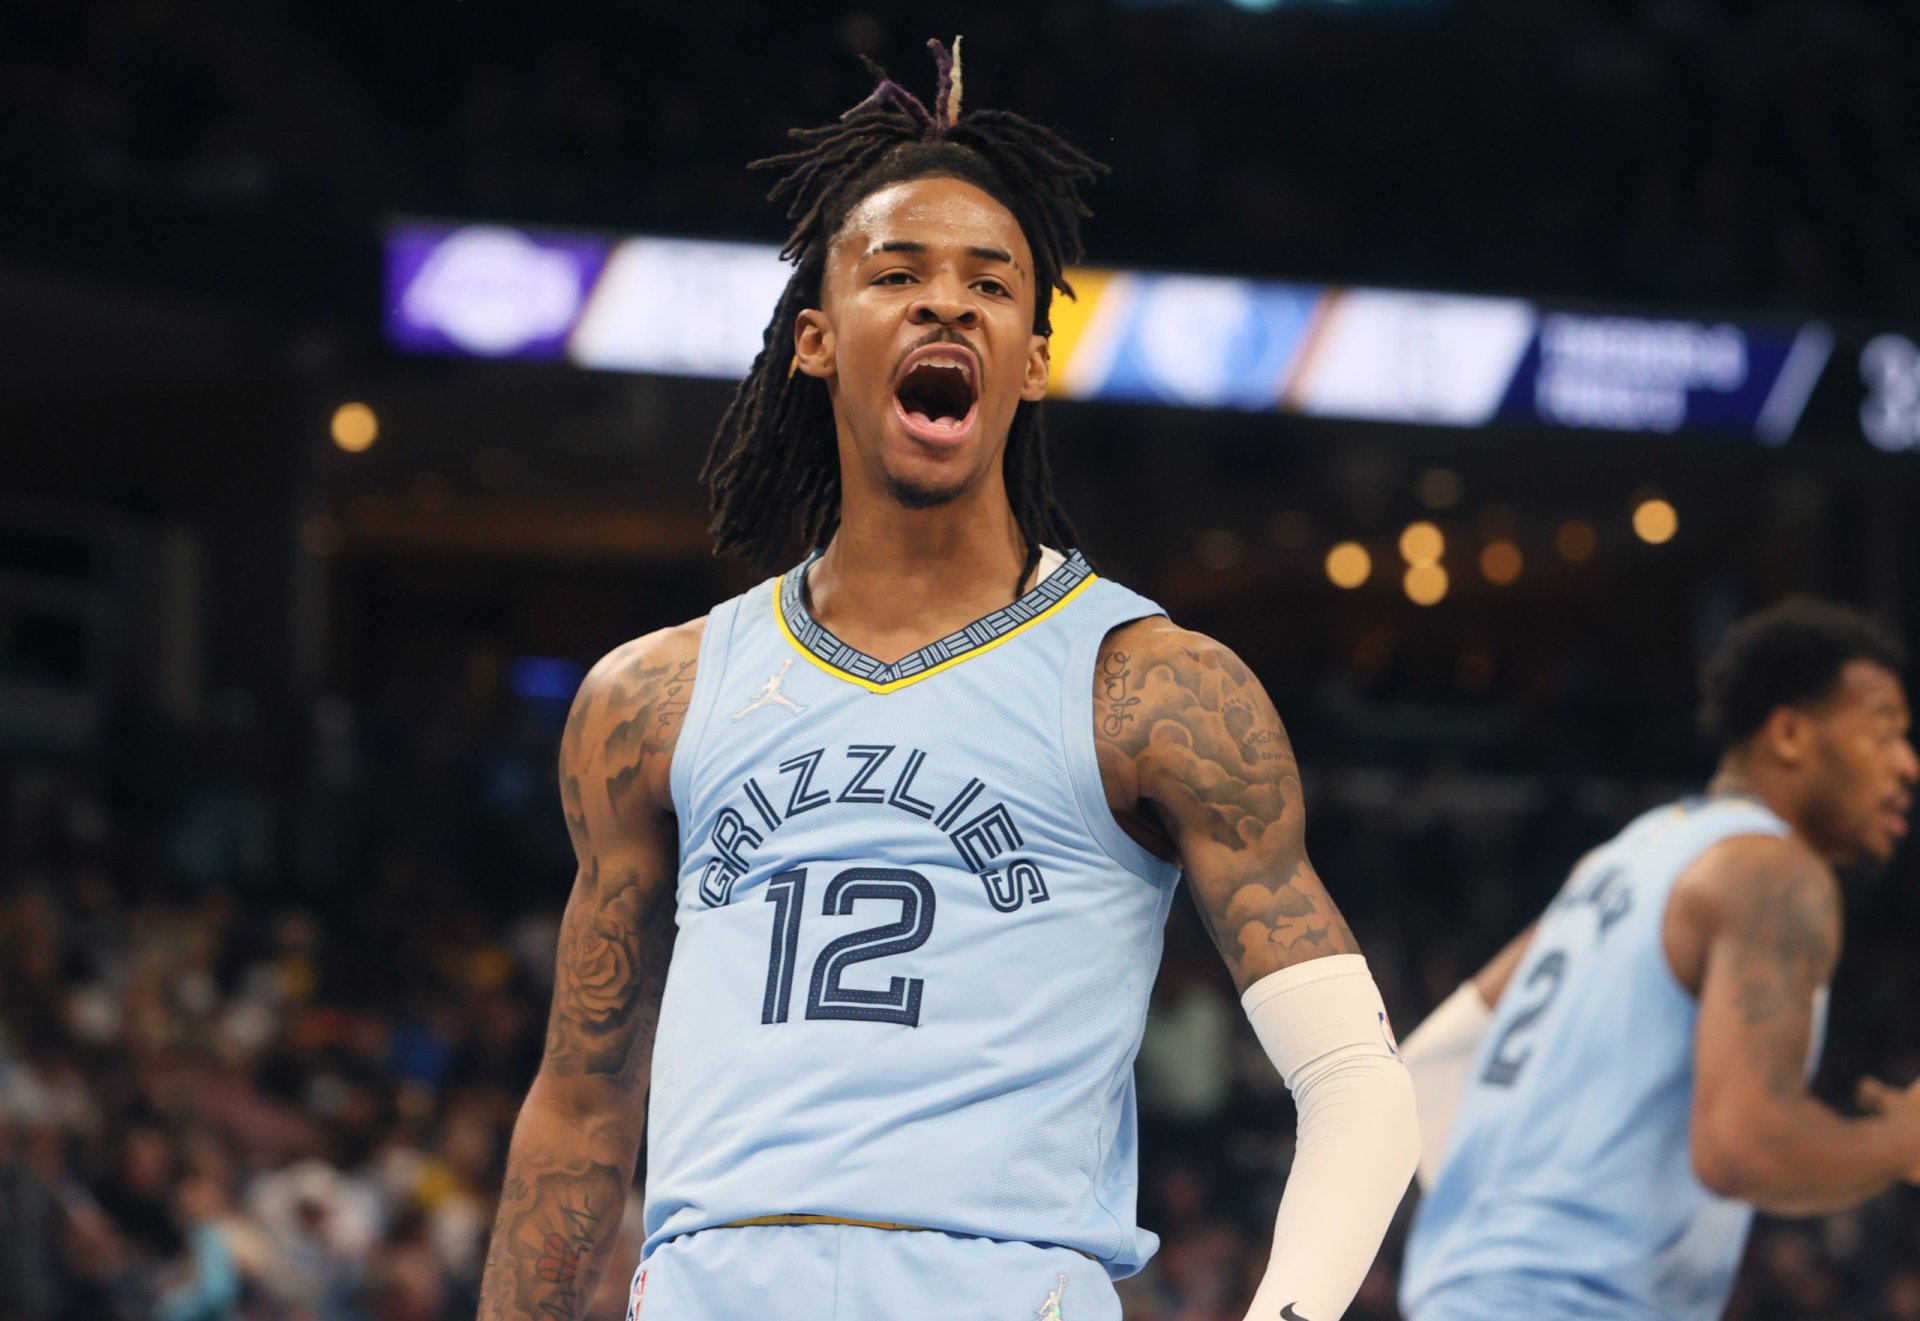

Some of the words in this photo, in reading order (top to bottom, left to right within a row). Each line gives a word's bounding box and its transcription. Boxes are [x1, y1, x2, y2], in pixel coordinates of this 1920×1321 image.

[699, 744, 1050, 913] GRIZZLIES
[761, 866, 937, 1028] 12
[1480, 950, 1568, 1087] 2
